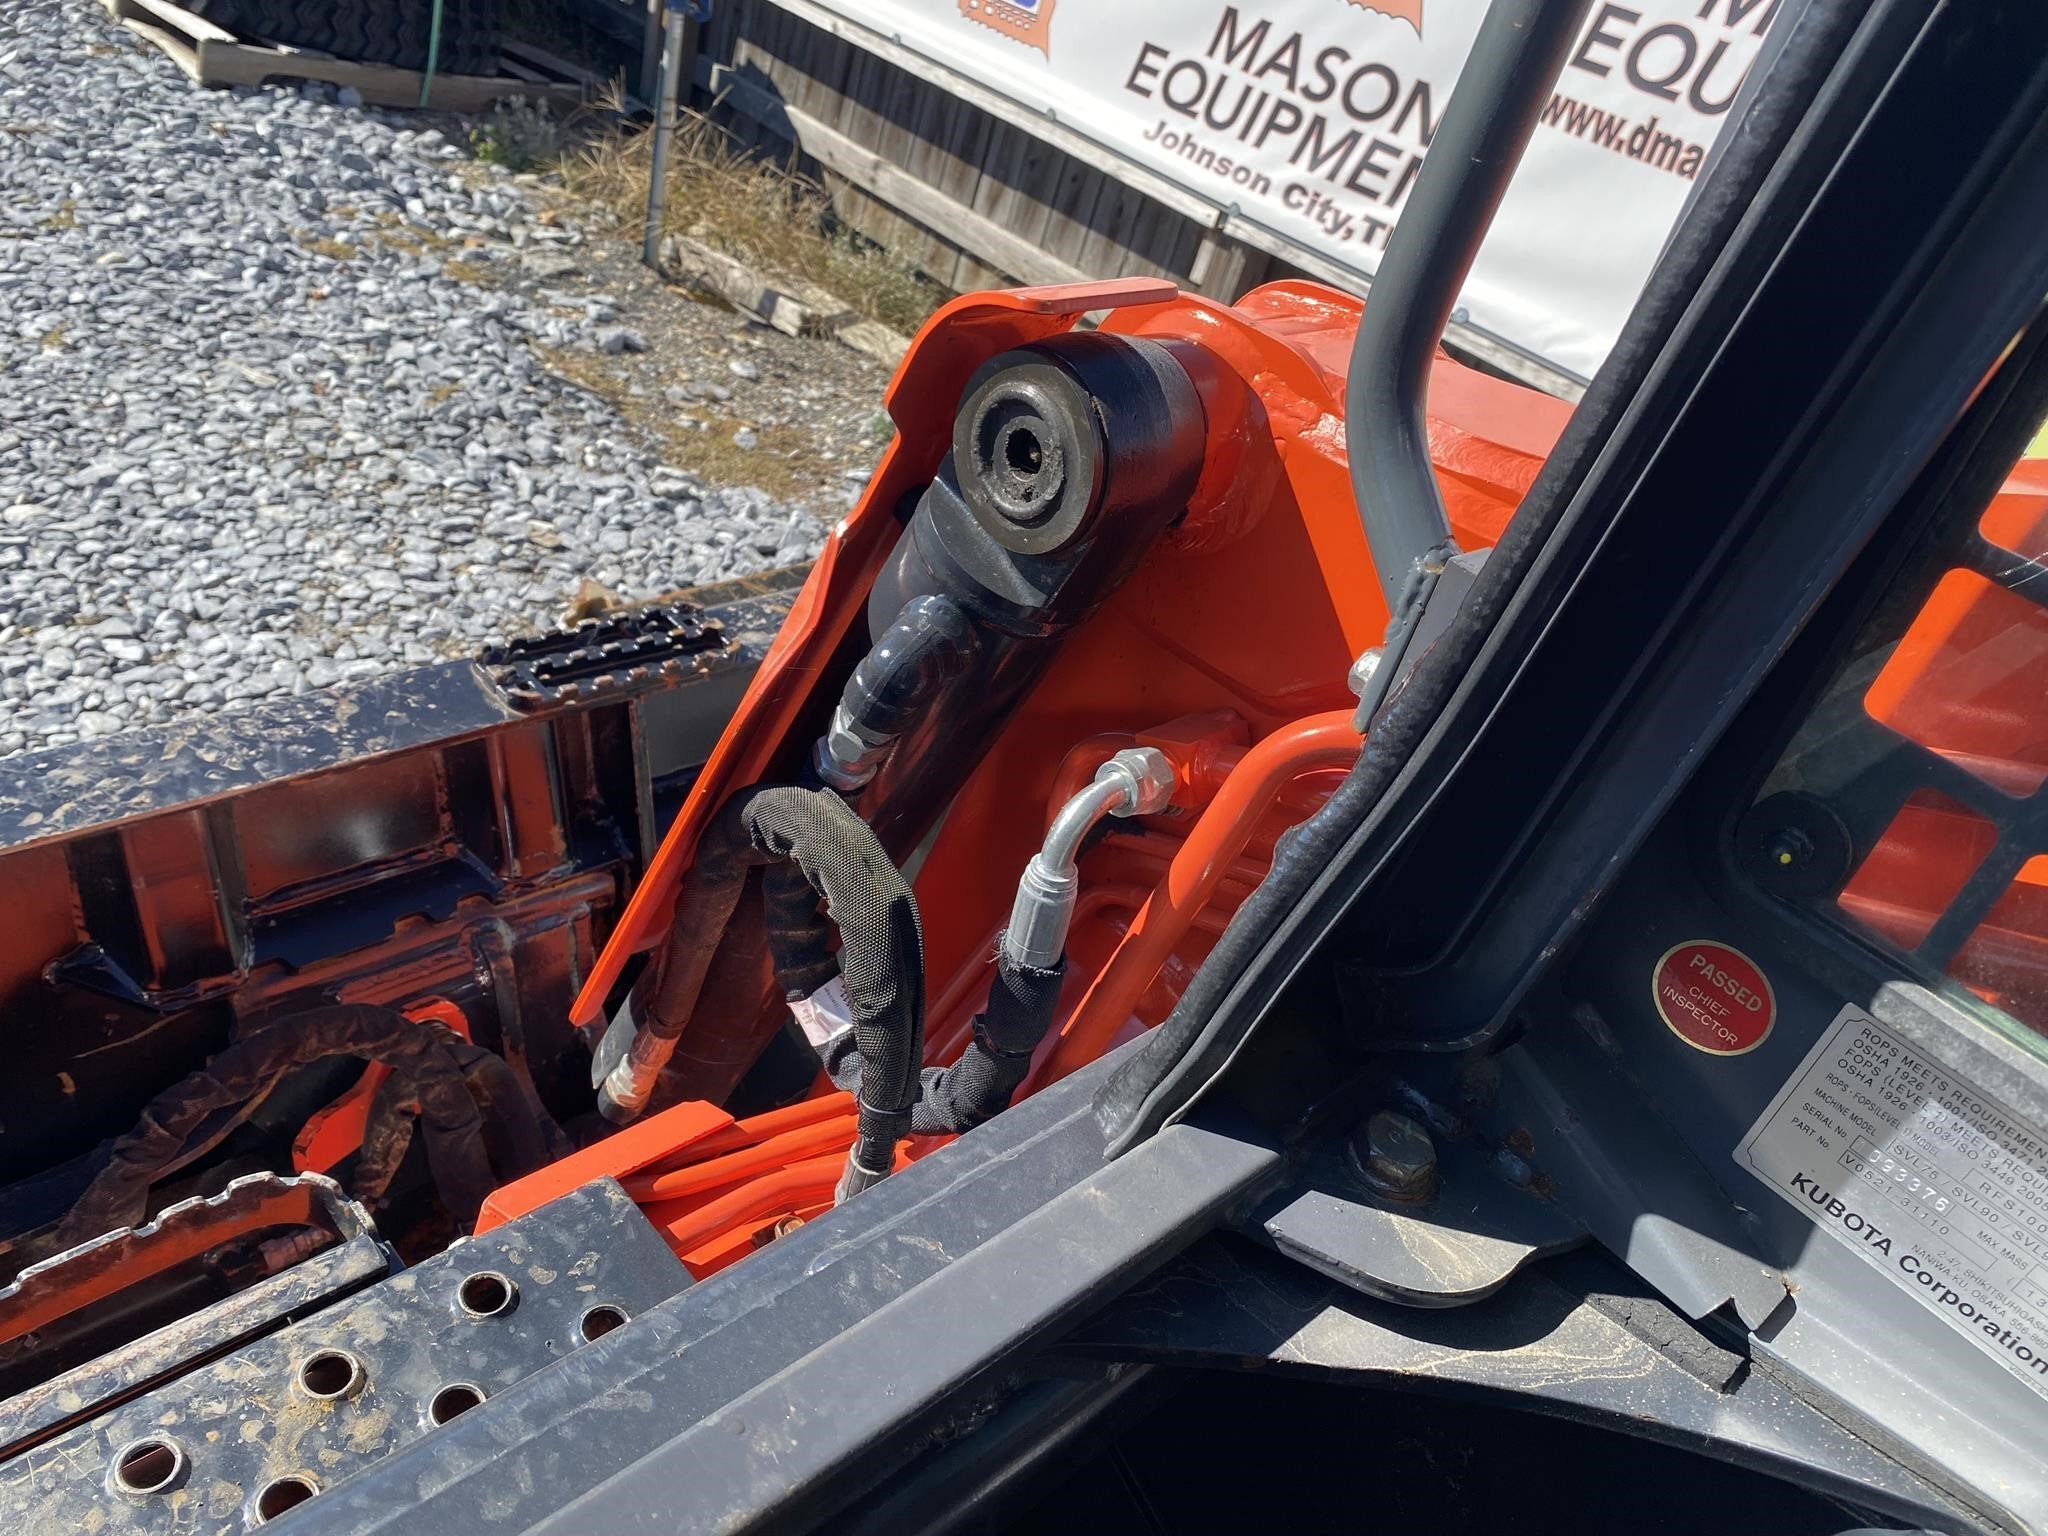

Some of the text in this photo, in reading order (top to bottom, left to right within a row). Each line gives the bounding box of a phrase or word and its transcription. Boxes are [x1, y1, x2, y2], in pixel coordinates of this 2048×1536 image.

[1206, 6, 1446, 148] MASON
[1144, 120, 1272, 195] Johnson
[1540, 94, 1706, 181] www.dma
[1663, 986, 1738, 1045] INSPECTOR
[1689, 954, 1762, 1011] PASSED
[1689, 986, 1731, 1017] CHIEF
[1792, 1118, 1814, 1136] PART
[1802, 1103, 1833, 1126] SERIAL
[1825, 1073, 1848, 1091] ROPS
[1853, 1093, 1901, 1129] FOPS(LEVEL
[1911, 1134, 1938, 1154] MODEL
[1837, 1058, 1873, 1085] OSHA
[1878, 1087, 1907, 1109] 1926
[1981, 1160, 2013, 1185] 3449
[1845, 1049, 1880, 1075] FOPS
[1883, 1076, 1930, 1109] (LEVEL
[1934, 1111, 1947, 1123] 1)
[1951, 1123, 1998, 1158] MEETS
[1853, 1039, 1889, 1066] OSHA
[1893, 1067, 1923, 1089] 1926
[1937, 1097, 1997, 1140] 1001/ISO
[2000, 1141, 2032, 1165] 3471
[1861, 1028, 2048, 1159] ROPS MEETS REQUIREMEN
[1814, 1088, 1848, 1114] MACHINE
[1849, 1114, 1876, 1135] MODEL
[1893, 1145, 1938, 1178] SVL75
[1951, 1186, 1998, 1222] SVL90
[1790, 1172, 2048, 1375] KUBOTA Corporation
[1977, 1231, 2027, 1269] MAX MASS
[1971, 1288, 2006, 1317] OSAKA
